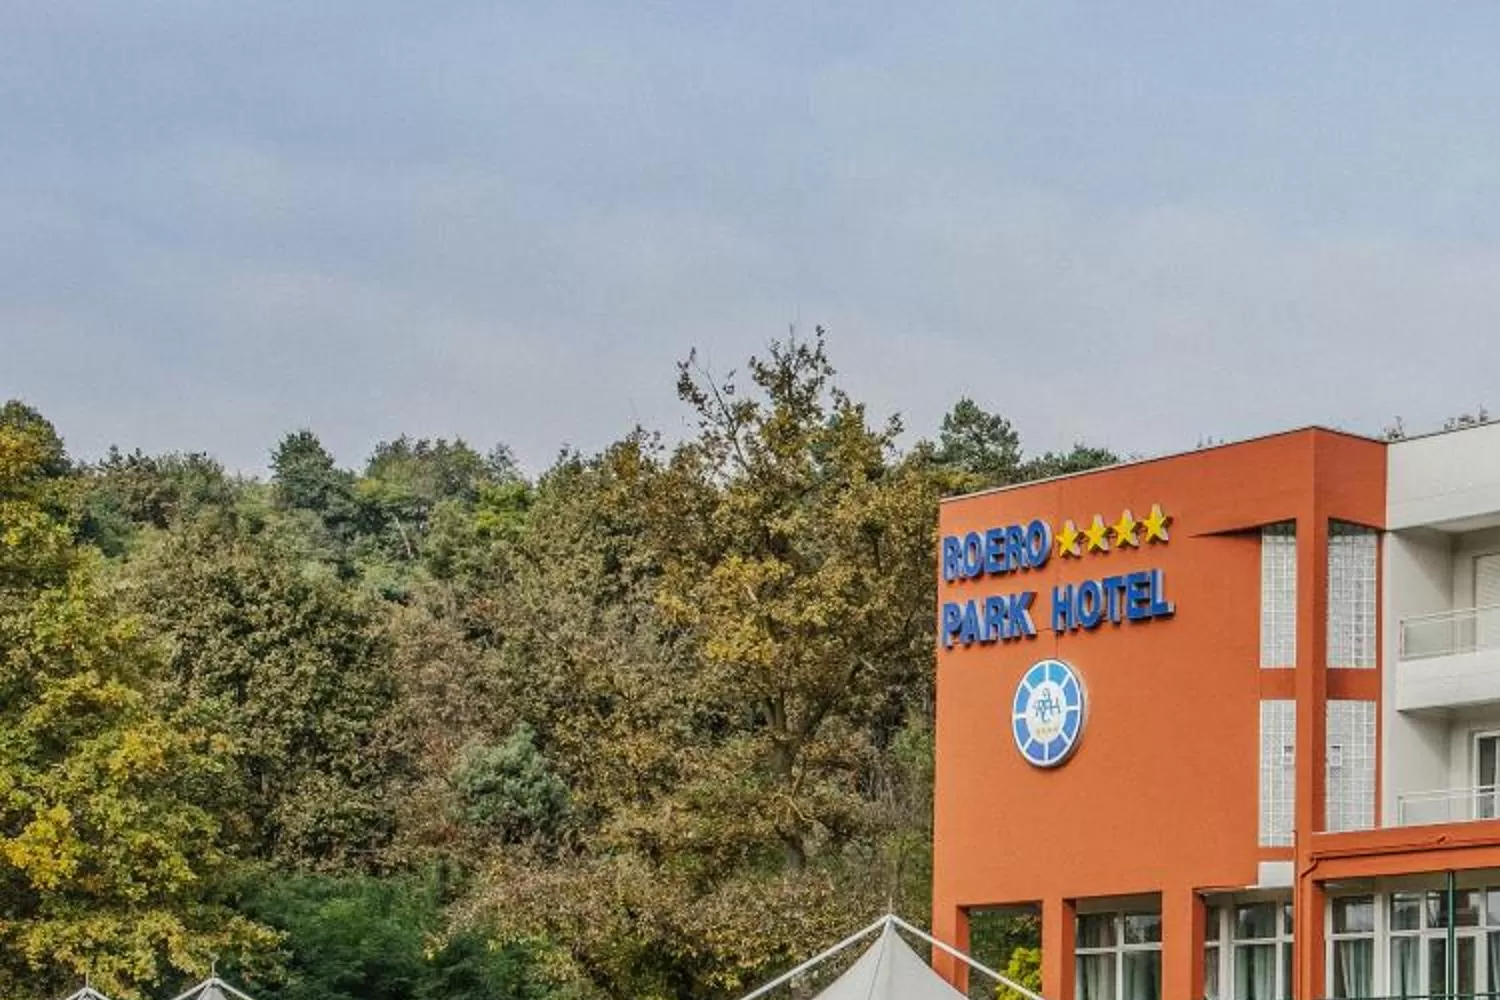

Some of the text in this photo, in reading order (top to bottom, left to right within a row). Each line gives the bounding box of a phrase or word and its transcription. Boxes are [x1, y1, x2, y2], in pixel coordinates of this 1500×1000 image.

[943, 519, 1052, 581] ROERO
[942, 568, 1175, 648] PARK HOTEL
